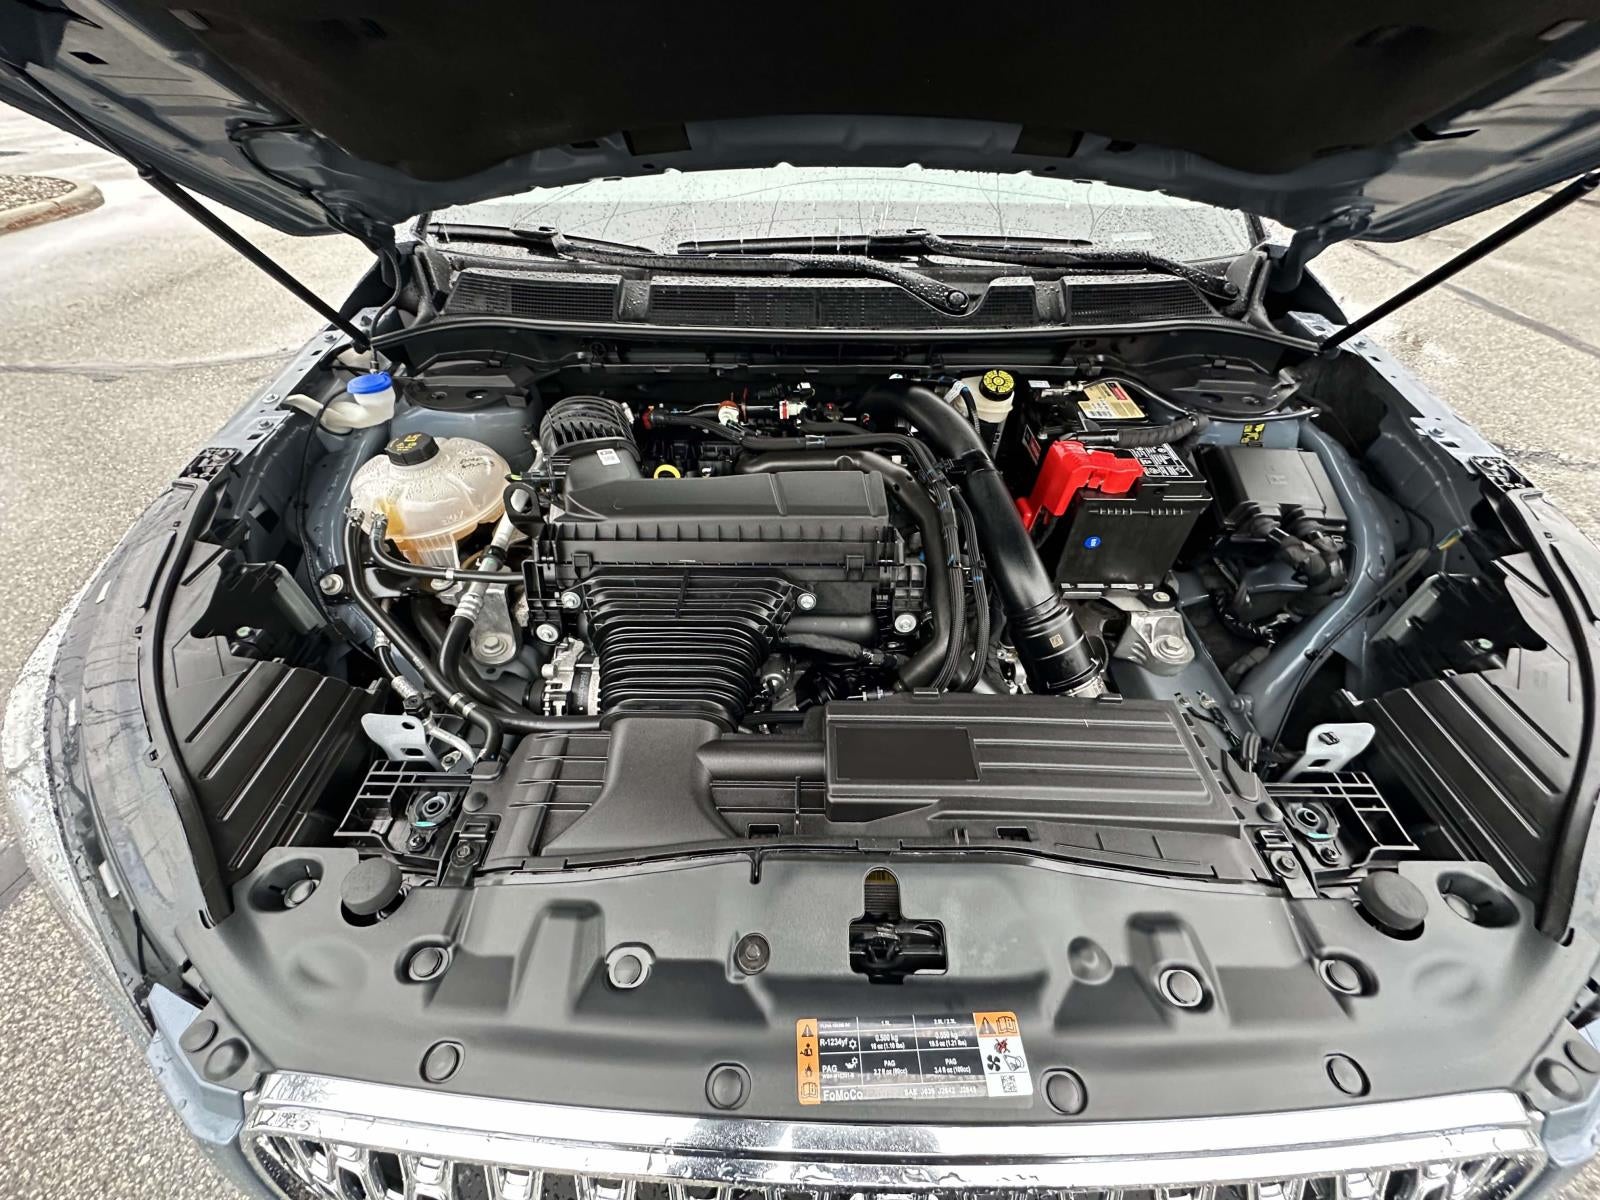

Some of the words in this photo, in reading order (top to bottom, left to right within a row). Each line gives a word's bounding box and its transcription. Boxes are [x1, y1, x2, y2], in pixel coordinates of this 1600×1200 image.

[820, 1038, 848, 1047] R-1234yf
[944, 1057, 957, 1066] PAG
[822, 1064, 838, 1073] PAG
[823, 1089, 864, 1101] FoMoCo
